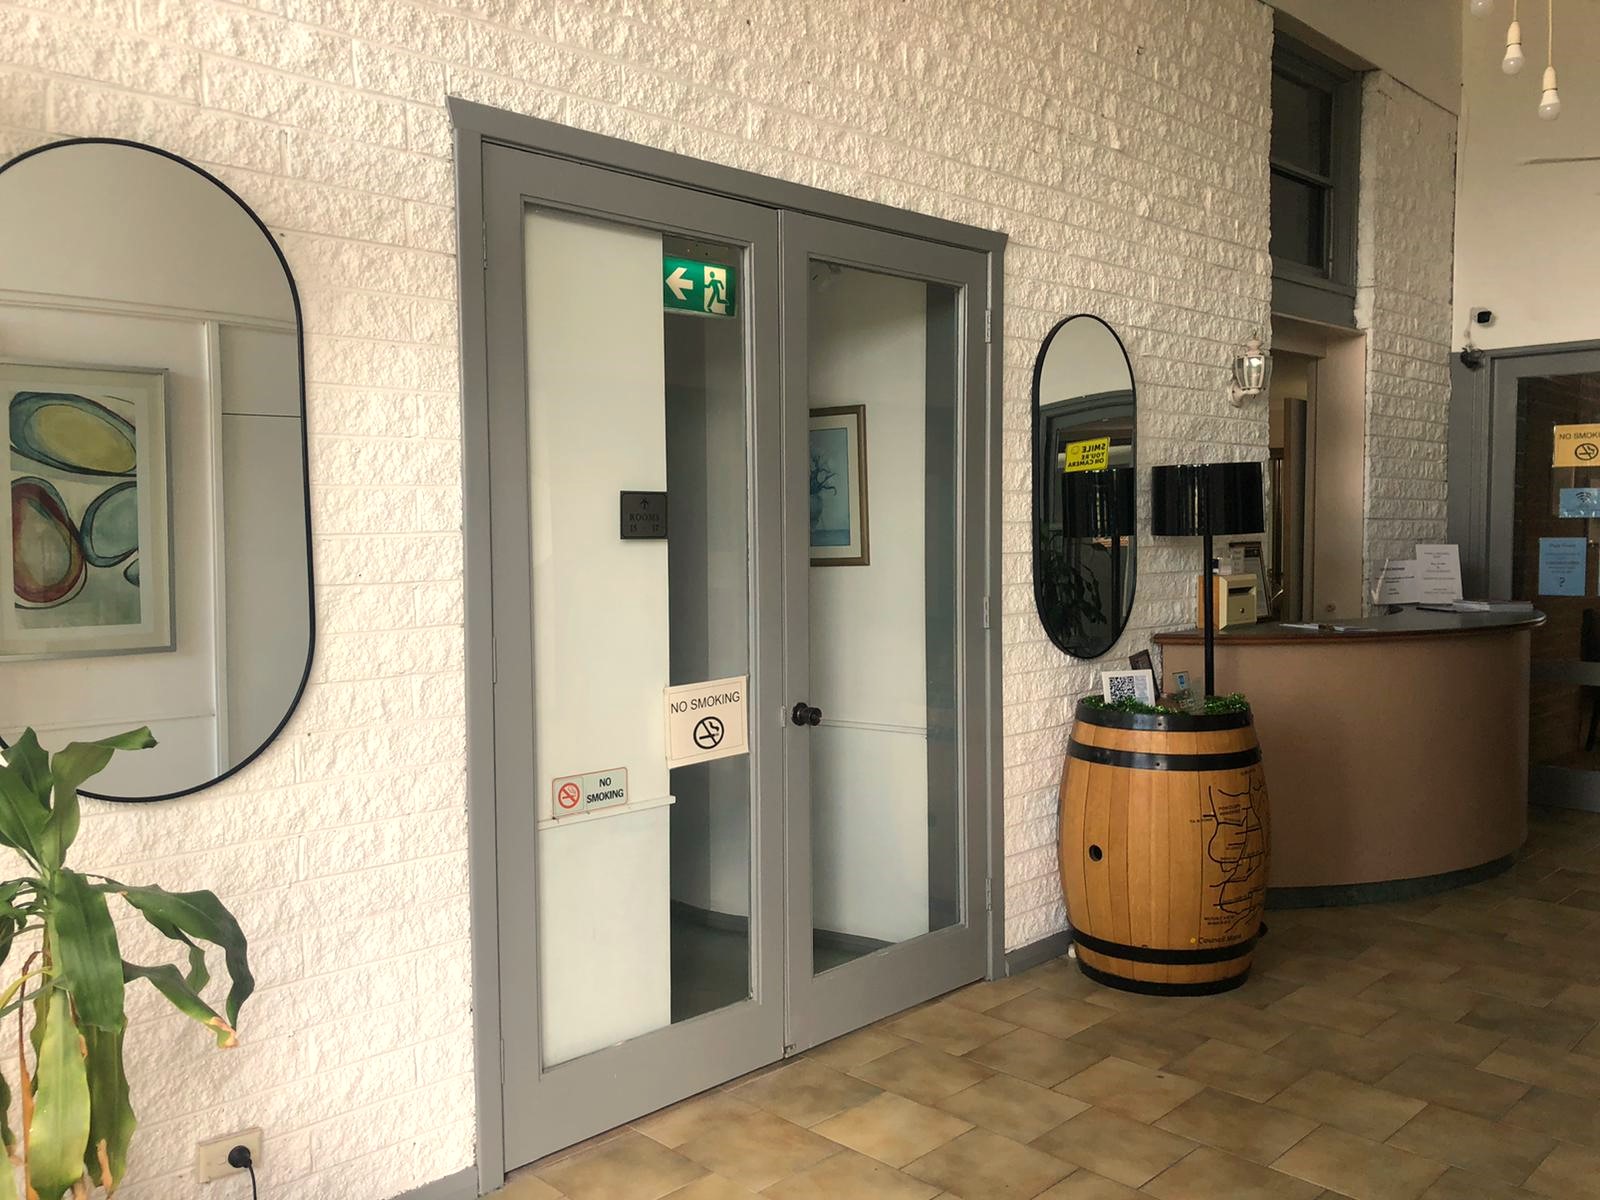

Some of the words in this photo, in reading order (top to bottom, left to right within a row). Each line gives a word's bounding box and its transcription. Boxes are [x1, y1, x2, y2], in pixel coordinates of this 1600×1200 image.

[1559, 432, 1572, 440] NO
[671, 700, 688, 714] NO
[690, 691, 740, 710] SMOKING
[599, 777, 612, 788] NO
[586, 788, 624, 804] SMOKING
